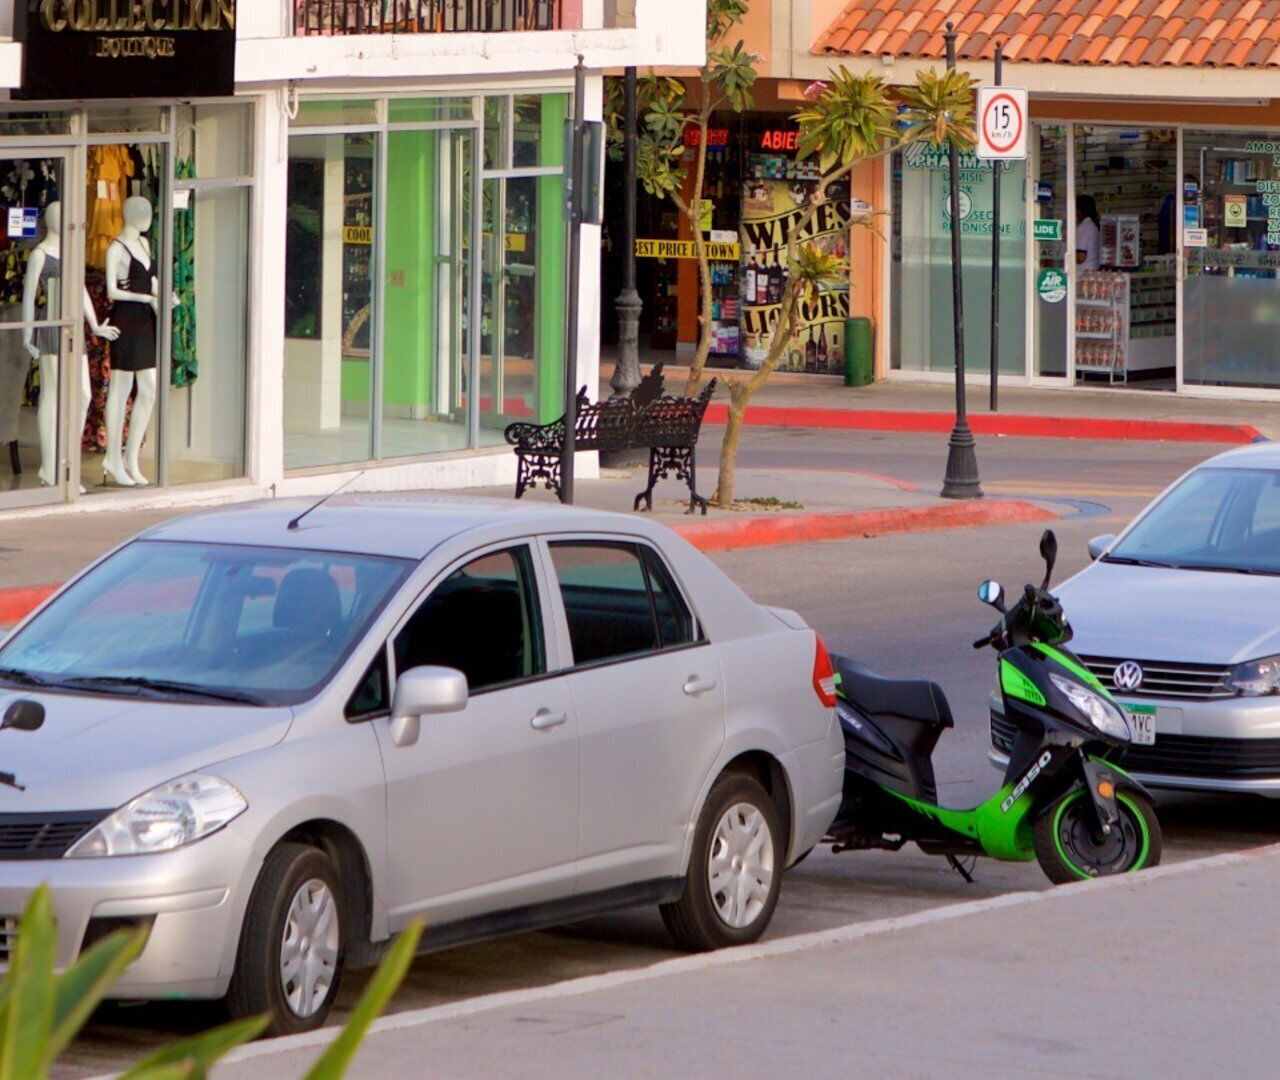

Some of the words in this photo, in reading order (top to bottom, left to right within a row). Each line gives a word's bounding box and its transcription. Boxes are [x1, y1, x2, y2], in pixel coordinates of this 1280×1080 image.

[95, 36, 176, 59] BOUTIQUE
[994, 105, 1010, 130] 15
[915, 154, 1011, 170] PHARMAY
[943, 172, 984, 182] LMISIL
[743, 199, 851, 250] WINES
[658, 241, 688, 257] PRICE
[705, 243, 735, 258] TOWN
